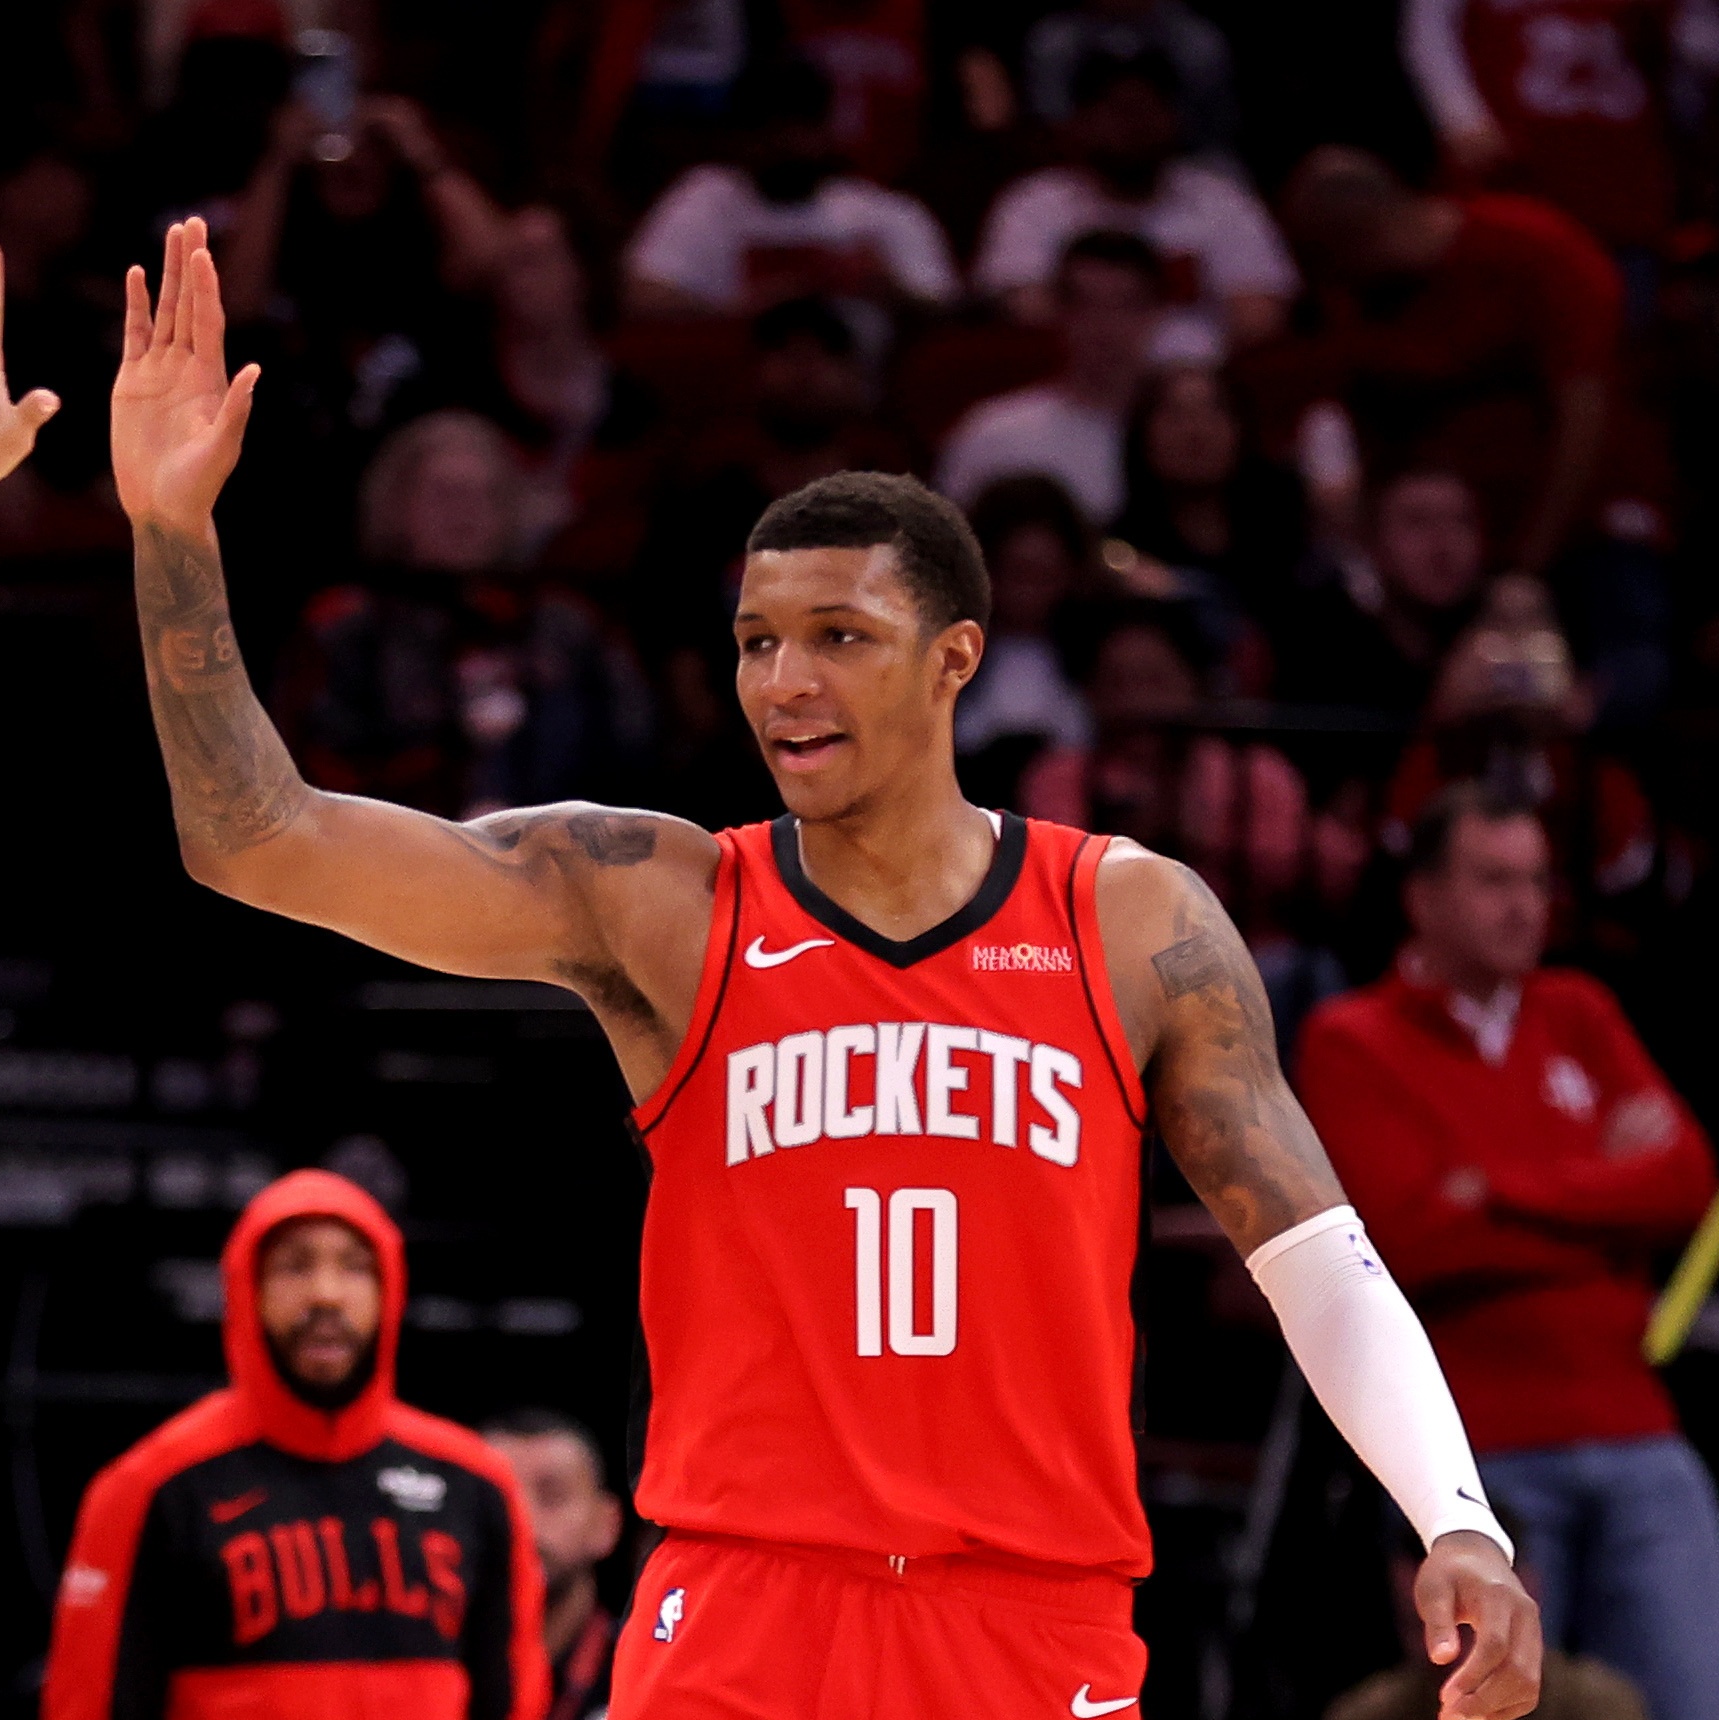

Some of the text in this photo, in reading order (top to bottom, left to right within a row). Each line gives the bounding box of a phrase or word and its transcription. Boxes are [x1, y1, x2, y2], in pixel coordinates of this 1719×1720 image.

[972, 956, 1073, 972] HERMANN
[973, 944, 1073, 961] MEMORIAL
[726, 1021, 1082, 1168] ROCKETS
[844, 1187, 958, 1357] 10
[219, 1513, 468, 1647] BULLS
